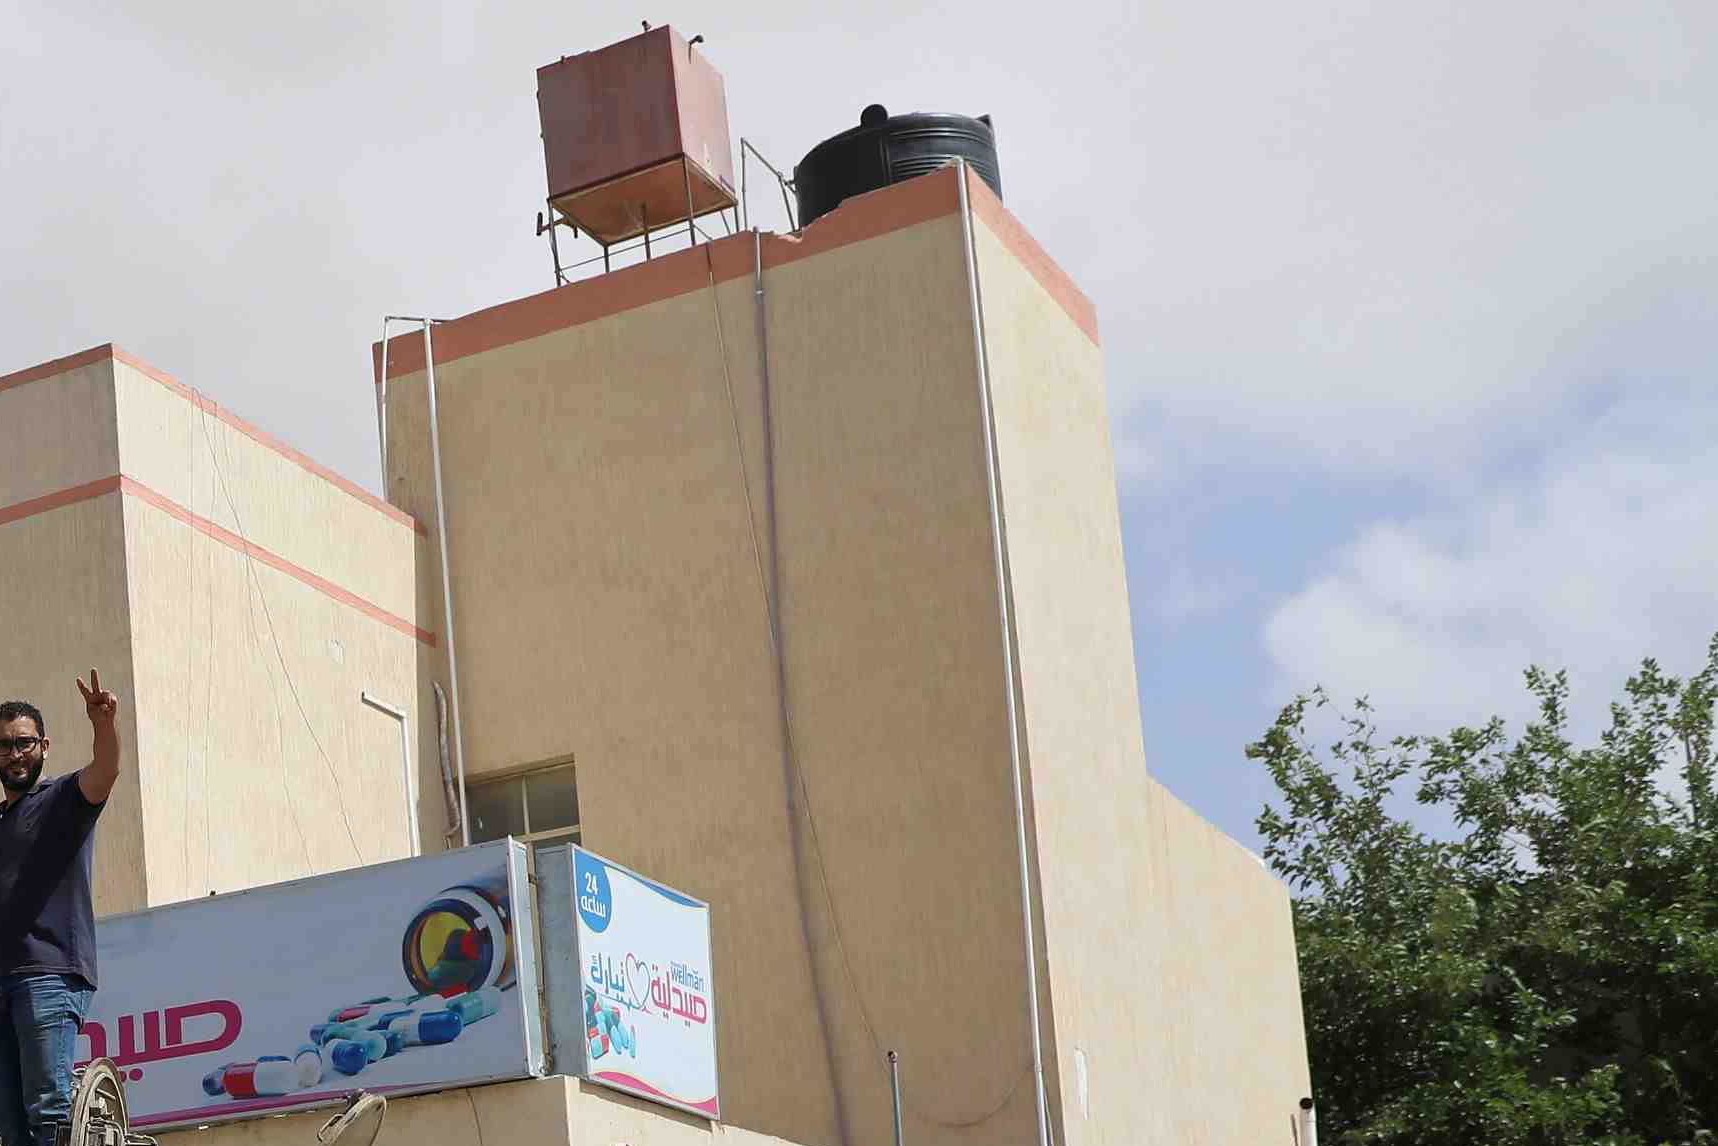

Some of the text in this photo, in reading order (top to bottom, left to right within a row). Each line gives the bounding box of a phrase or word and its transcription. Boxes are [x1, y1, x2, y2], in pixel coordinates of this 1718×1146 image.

[585, 872, 599, 896] 24
[590, 952, 707, 1028] صيدلية تبارك
